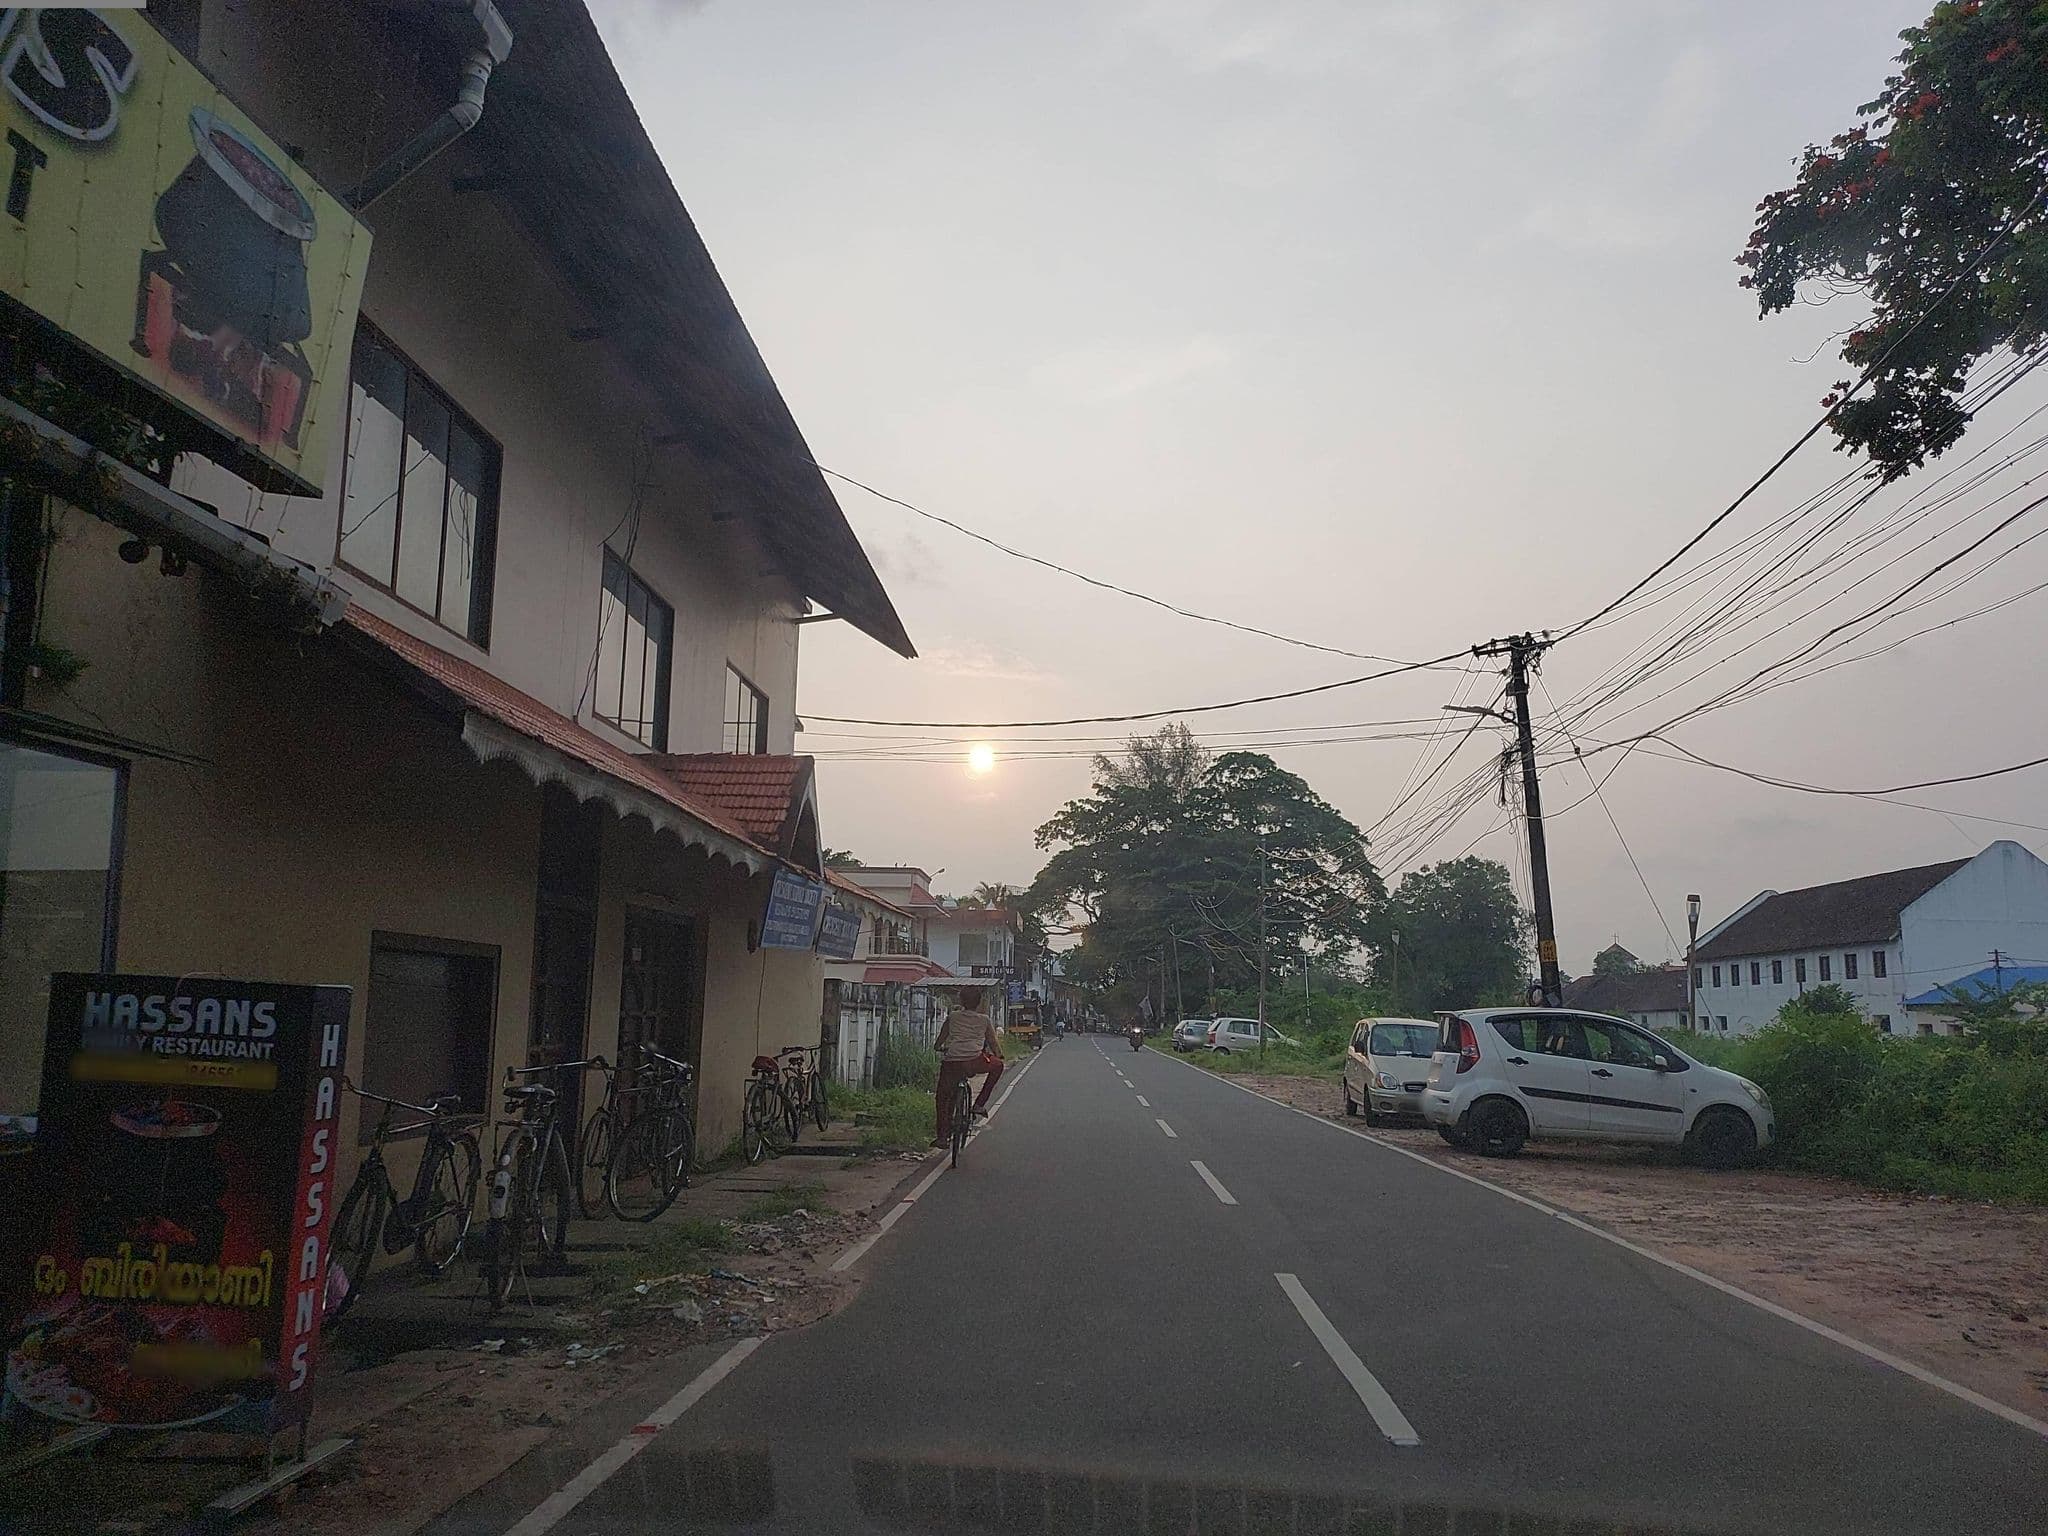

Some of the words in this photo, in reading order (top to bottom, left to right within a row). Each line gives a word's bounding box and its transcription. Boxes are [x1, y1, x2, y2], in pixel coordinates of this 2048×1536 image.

[83, 991, 278, 1038] HASSANS
[152, 1036, 275, 1059] RESTAURANT
[288, 1024, 341, 1392] HASSANS
